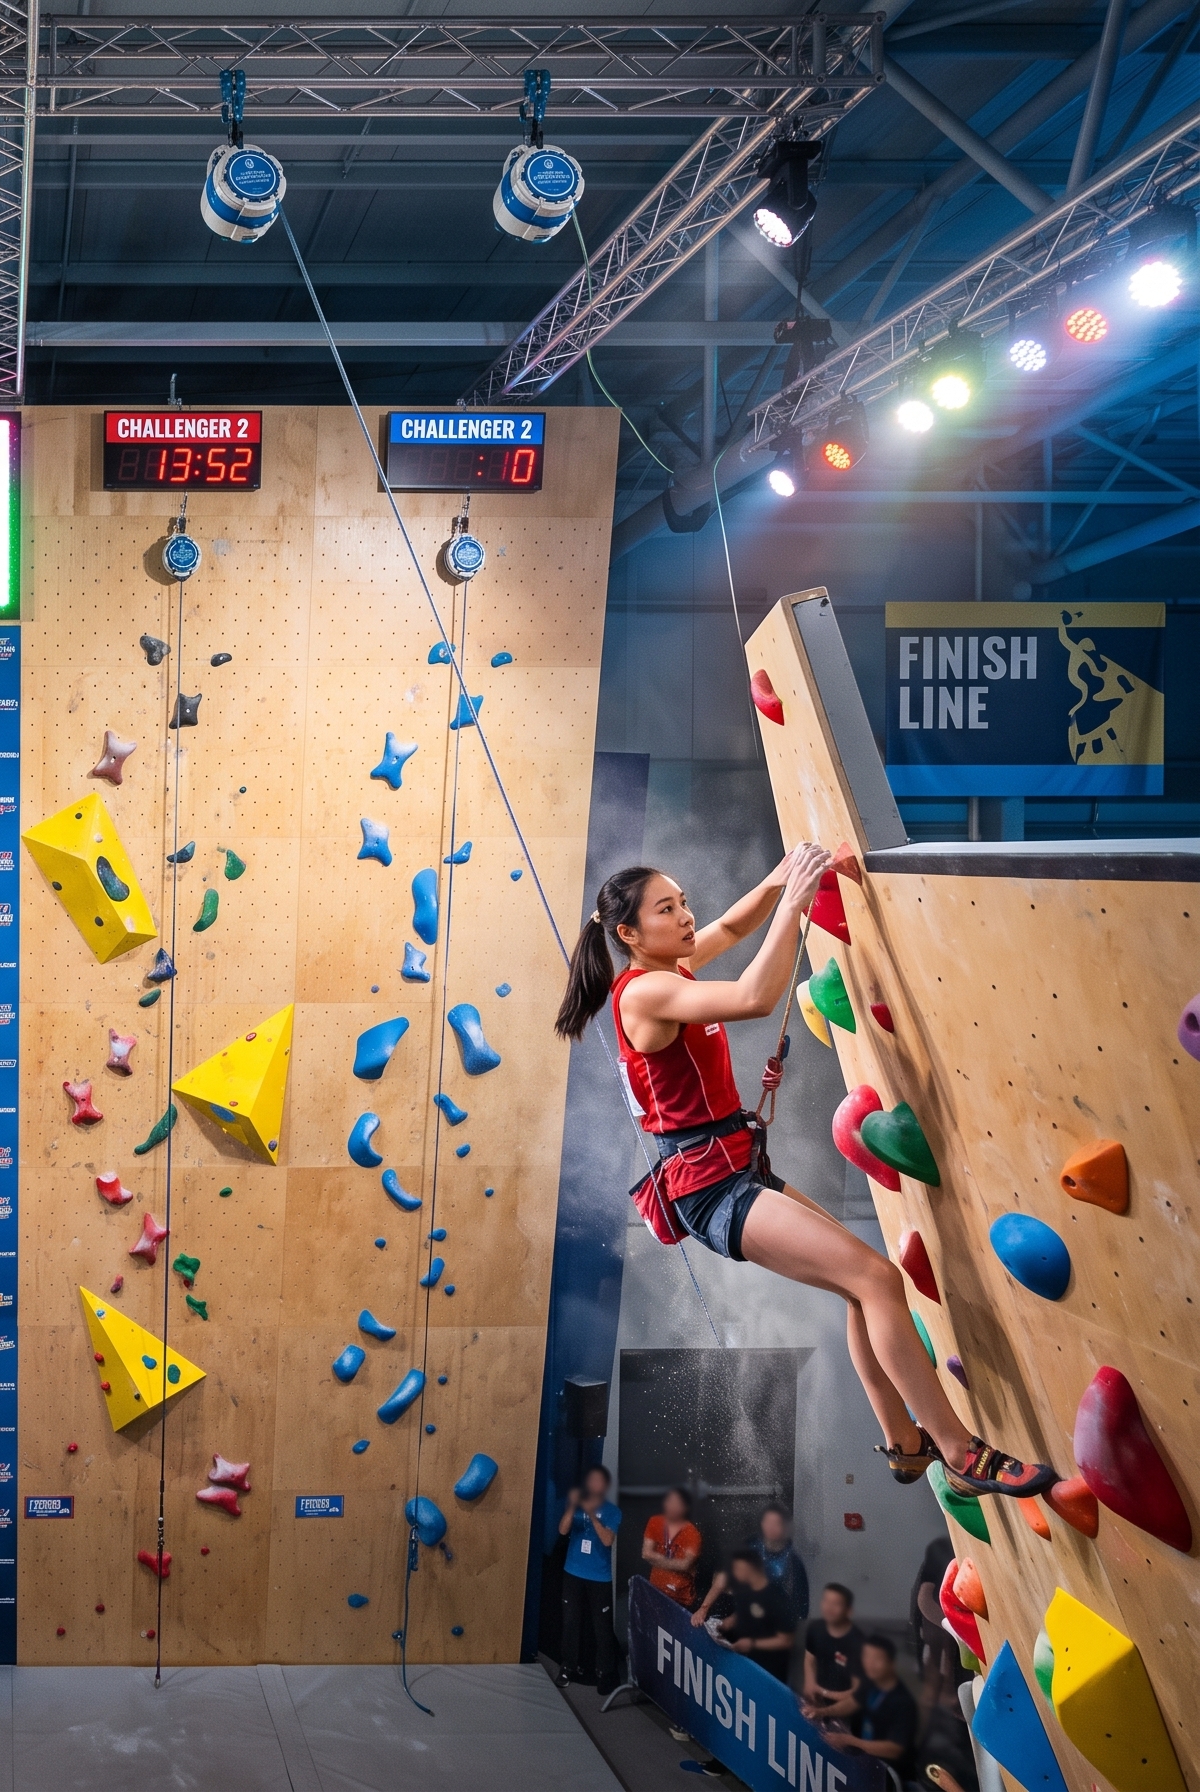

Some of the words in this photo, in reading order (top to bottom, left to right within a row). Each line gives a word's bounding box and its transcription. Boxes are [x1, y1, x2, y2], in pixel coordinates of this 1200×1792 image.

[117, 418, 231, 438] CHALLENGER
[237, 418, 249, 438] 2
[401, 419, 515, 439] CHALLENGER
[520, 419, 532, 439] 2
[158, 448, 252, 482] 13:52
[899, 636, 1038, 680] FINISH
[899, 686, 989, 729] LINE
[657, 1625, 756, 1752] FINISH
